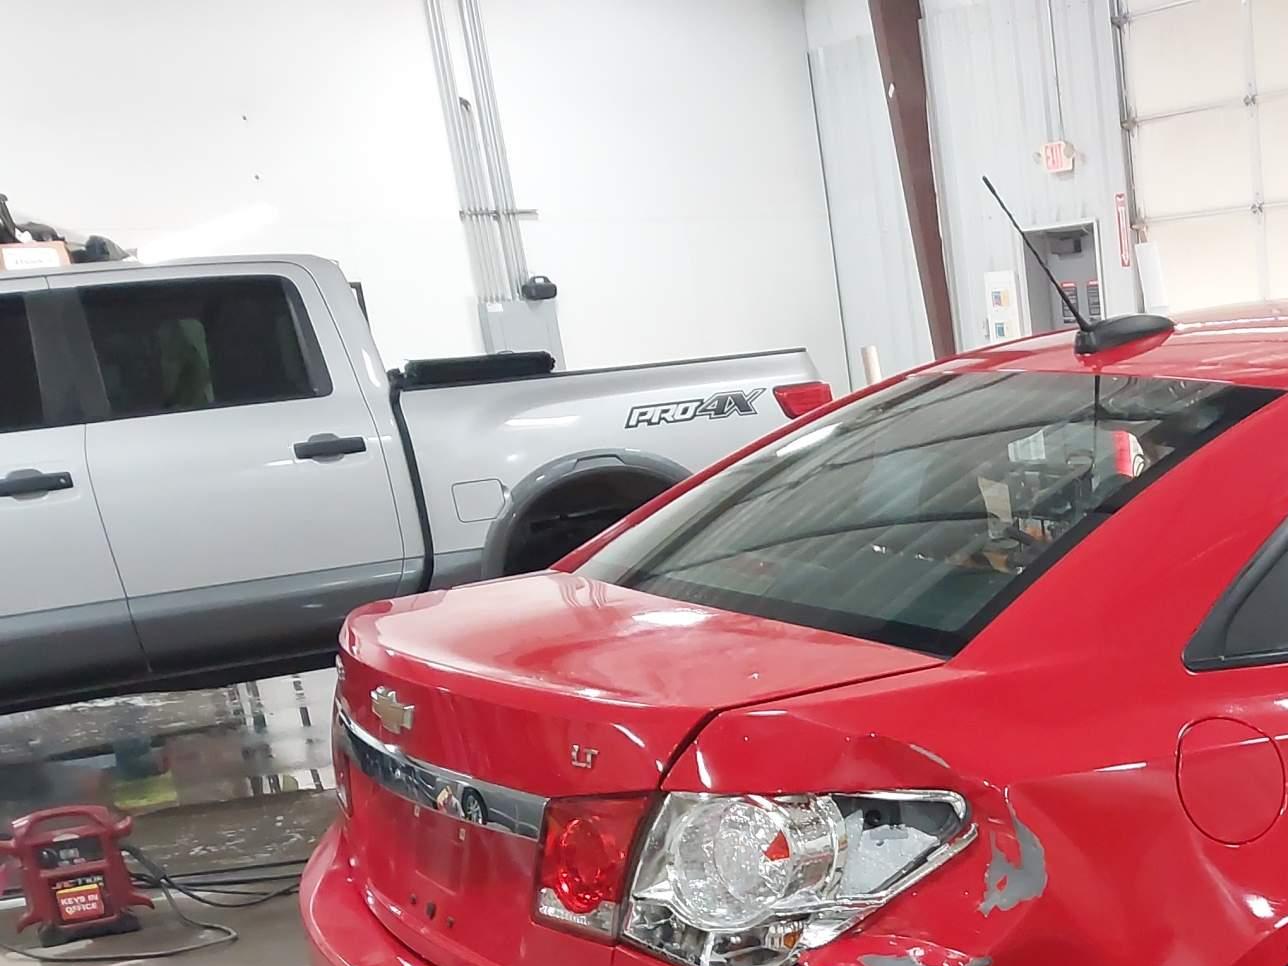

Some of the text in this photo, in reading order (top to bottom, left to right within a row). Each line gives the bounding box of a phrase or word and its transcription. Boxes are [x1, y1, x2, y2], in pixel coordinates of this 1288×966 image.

[571, 744, 599, 769] LT
[61, 893, 99, 906] KEYS IN
[65, 902, 98, 914] OFFICE
